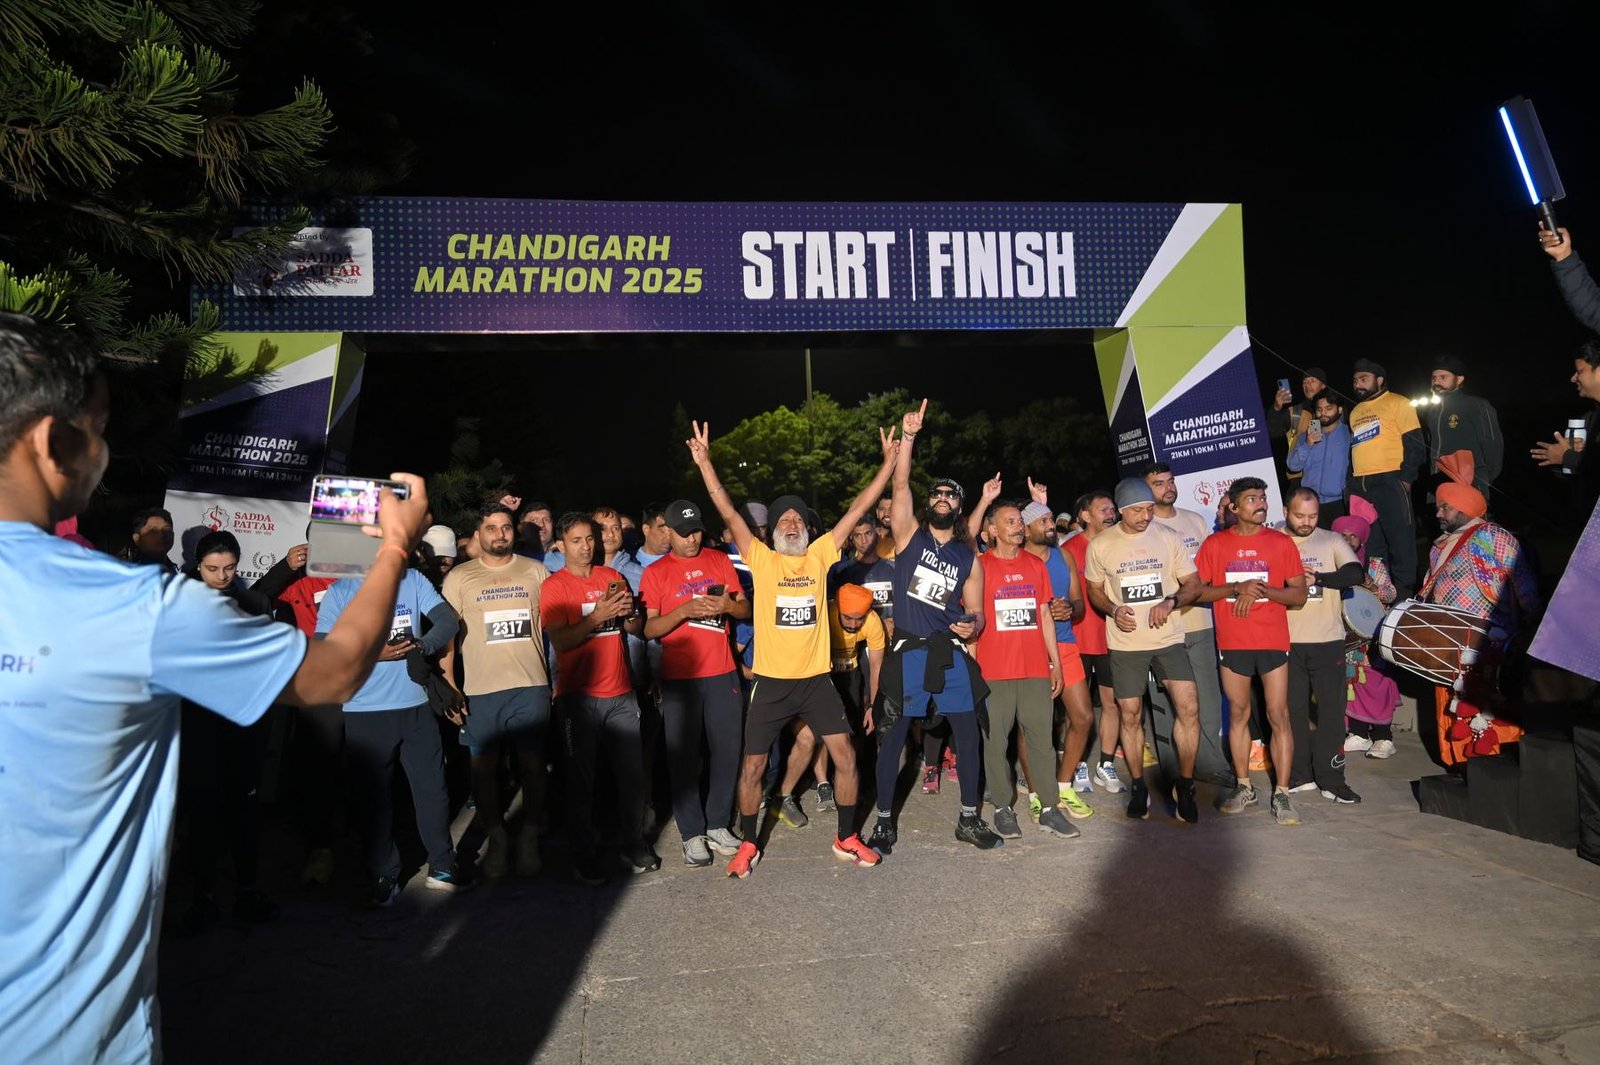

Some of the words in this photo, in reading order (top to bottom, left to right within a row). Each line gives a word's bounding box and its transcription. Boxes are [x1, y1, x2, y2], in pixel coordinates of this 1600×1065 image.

[447, 233, 671, 262] CHANDIGARH
[741, 230, 896, 300] START
[927, 230, 1077, 299] FINISH
[412, 265, 617, 295] MARATHON
[620, 266, 704, 295] 2025
[1173, 409, 1245, 432] CHANDIGARH
[1165, 424, 1228, 446] MARATHON
[1229, 418, 1256, 434] 2025
[204, 432, 298, 452] CHANDIGARH
[1171, 449, 1190, 460] 21KM
[1194, 445, 1214, 456] 10KM
[1218, 440, 1236, 452] 5KM
[1240, 436, 1256, 448] 3KM
[189, 442, 271, 464] MARATHON
[272, 450, 310, 466] 2025
[234, 512, 272, 522] SADDA
[234, 520, 275, 531] PATTAR
[1116, 566, 1148, 574] MAATHON
[1120, 558, 1158, 568] CHADIGARH
[236, 570, 264, 578] YBER
[482, 586, 524, 595] CHANDIGARH
[1128, 584, 1156, 599] 2729
[397, 608, 412, 616] 2025
[782, 608, 811, 622] 2506
[1002, 609, 1030, 623] 2504
[492, 620, 523, 636] 2317
